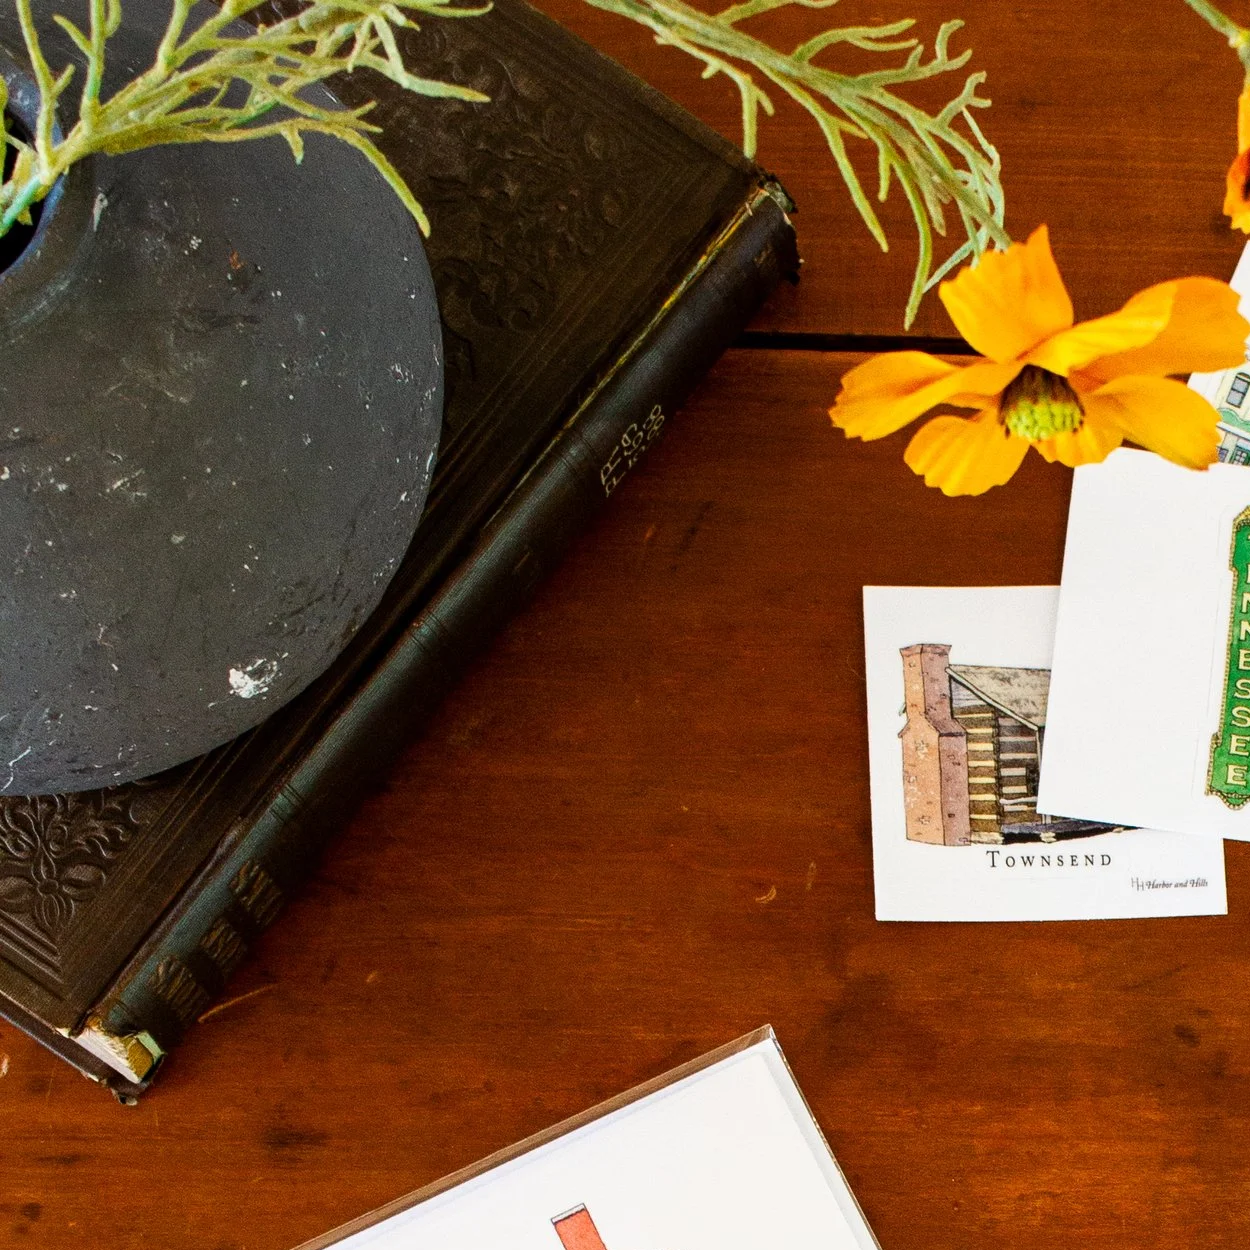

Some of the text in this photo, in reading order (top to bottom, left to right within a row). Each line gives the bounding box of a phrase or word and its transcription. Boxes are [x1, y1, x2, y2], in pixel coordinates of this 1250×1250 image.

[985, 850, 1112, 869] TOWNSEND
[1145, 877, 1208, 890] Harbor and Hills
